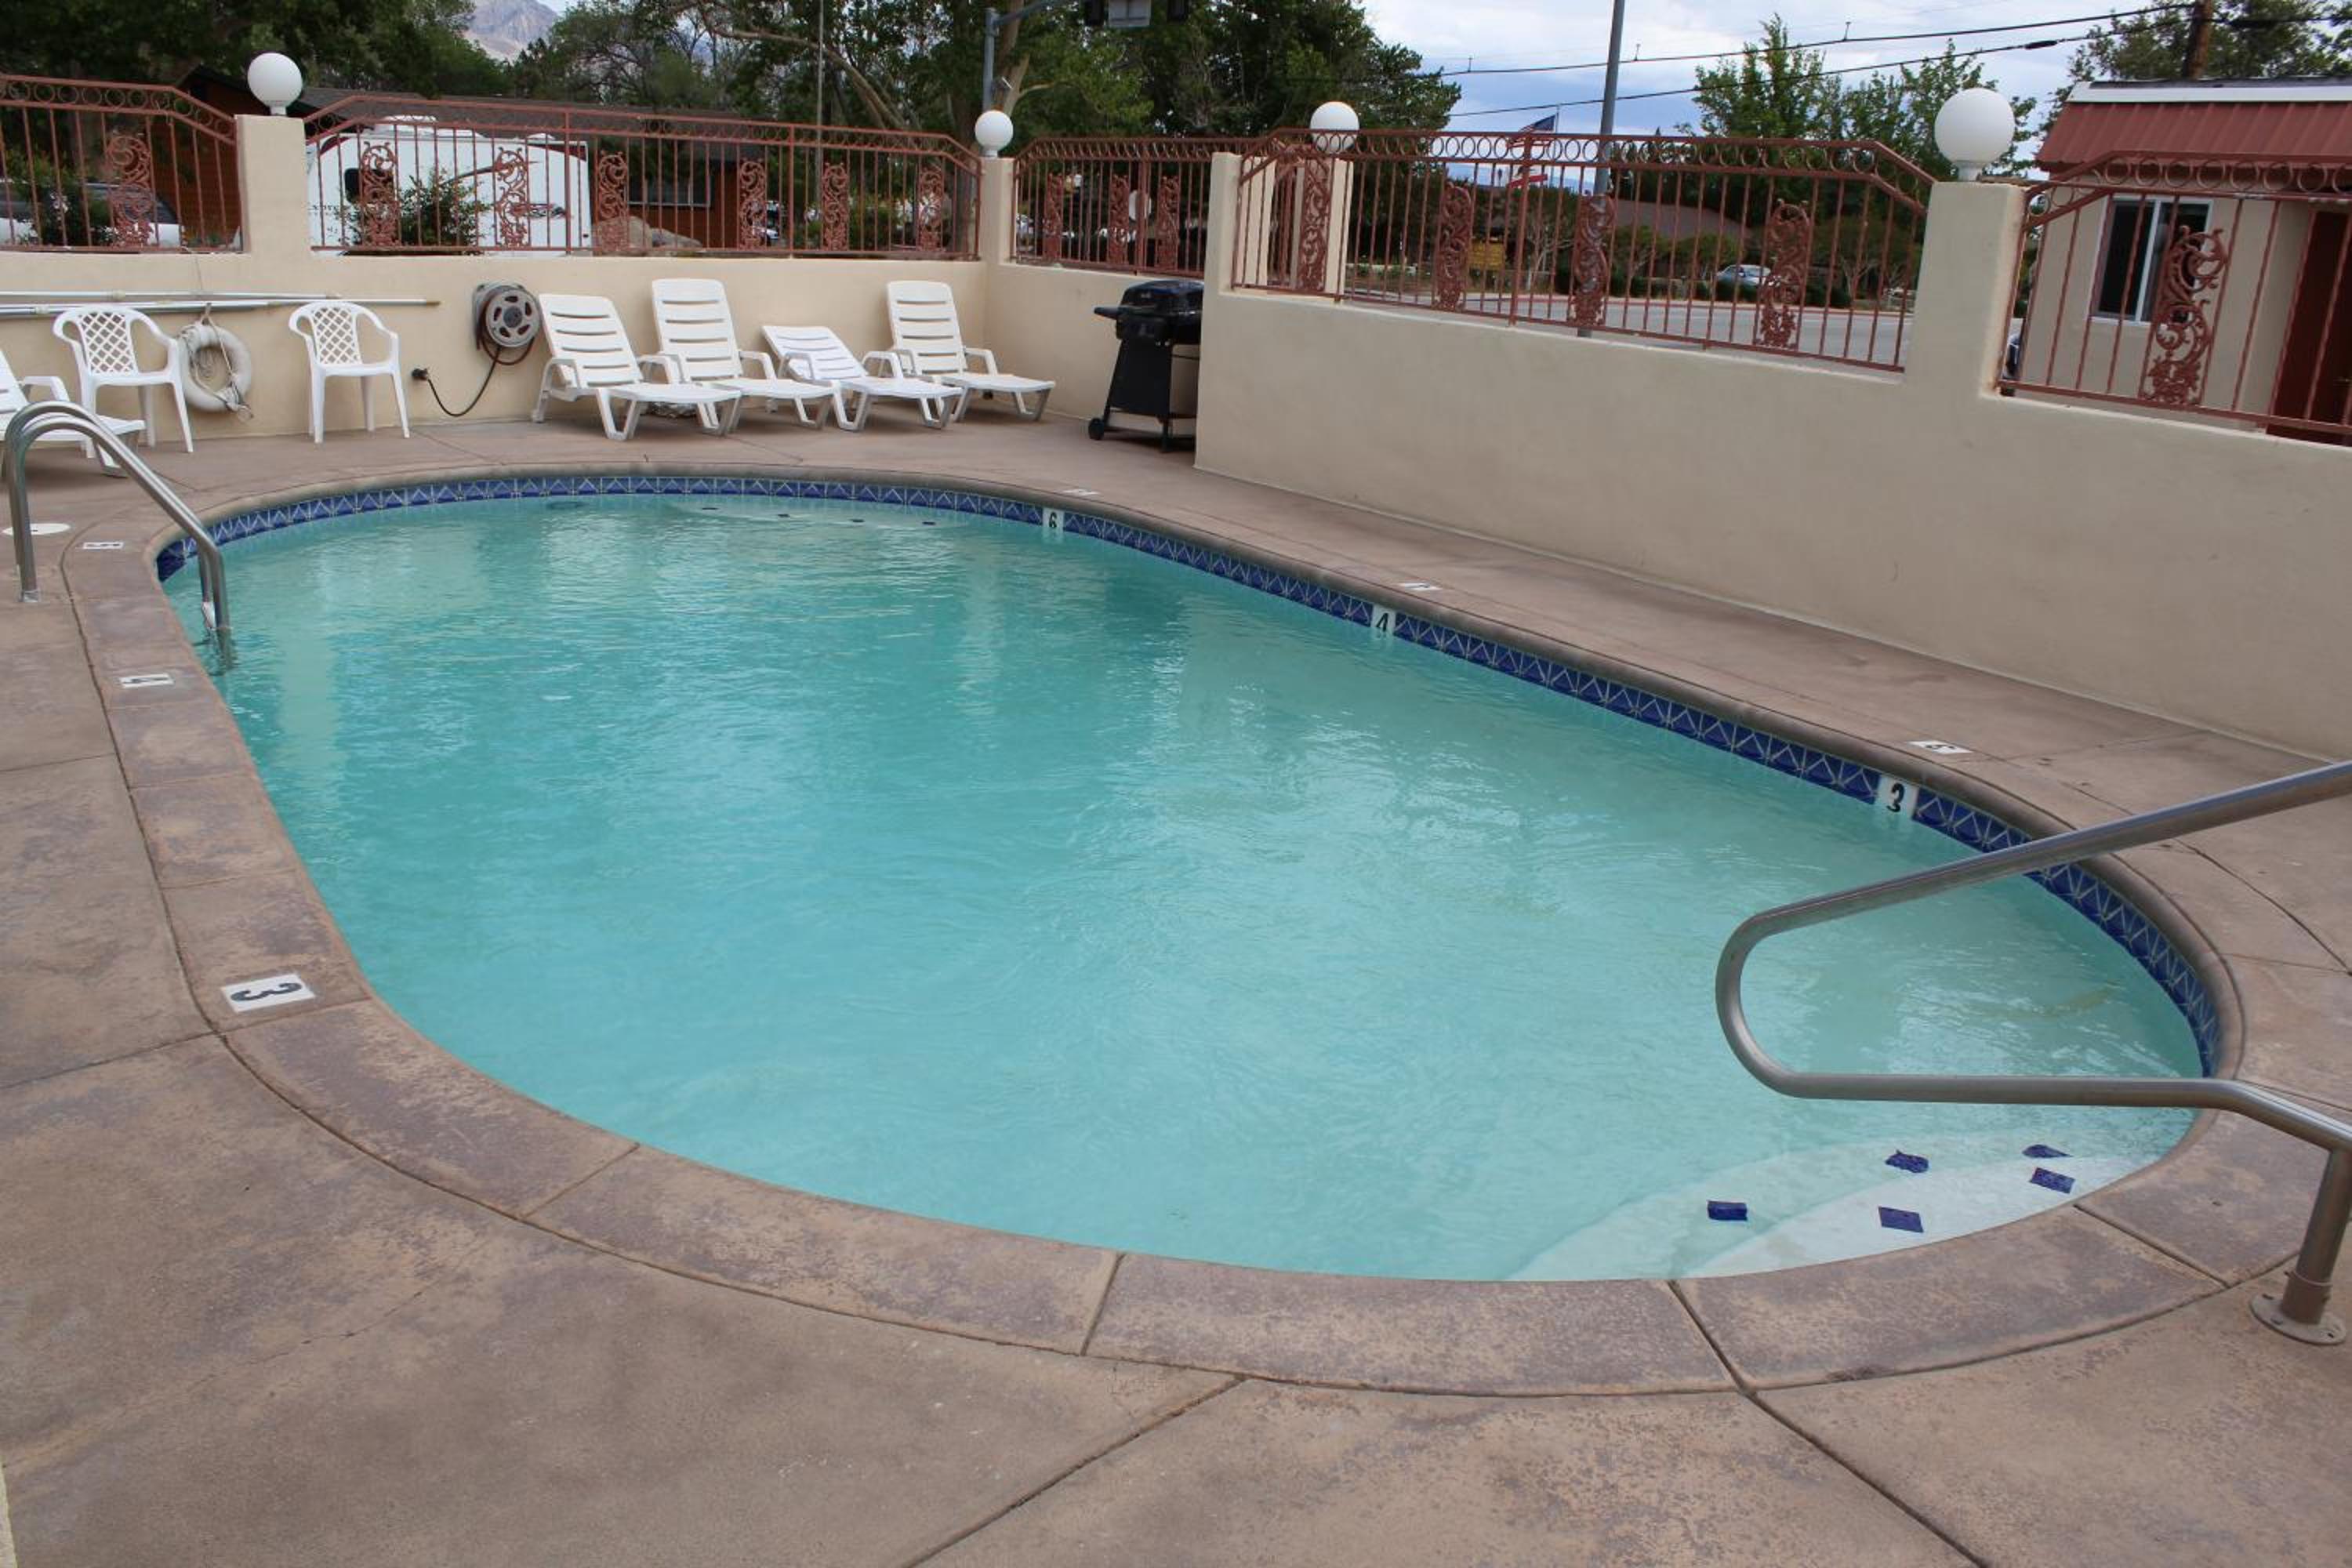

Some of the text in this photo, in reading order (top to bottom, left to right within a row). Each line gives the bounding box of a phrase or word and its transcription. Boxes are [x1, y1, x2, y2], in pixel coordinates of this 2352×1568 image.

[1048, 511, 1058, 528] 6
[1375, 612, 1389, 633] 4
[1886, 782, 1905, 813] 3
[230, 982, 303, 1002] 3
